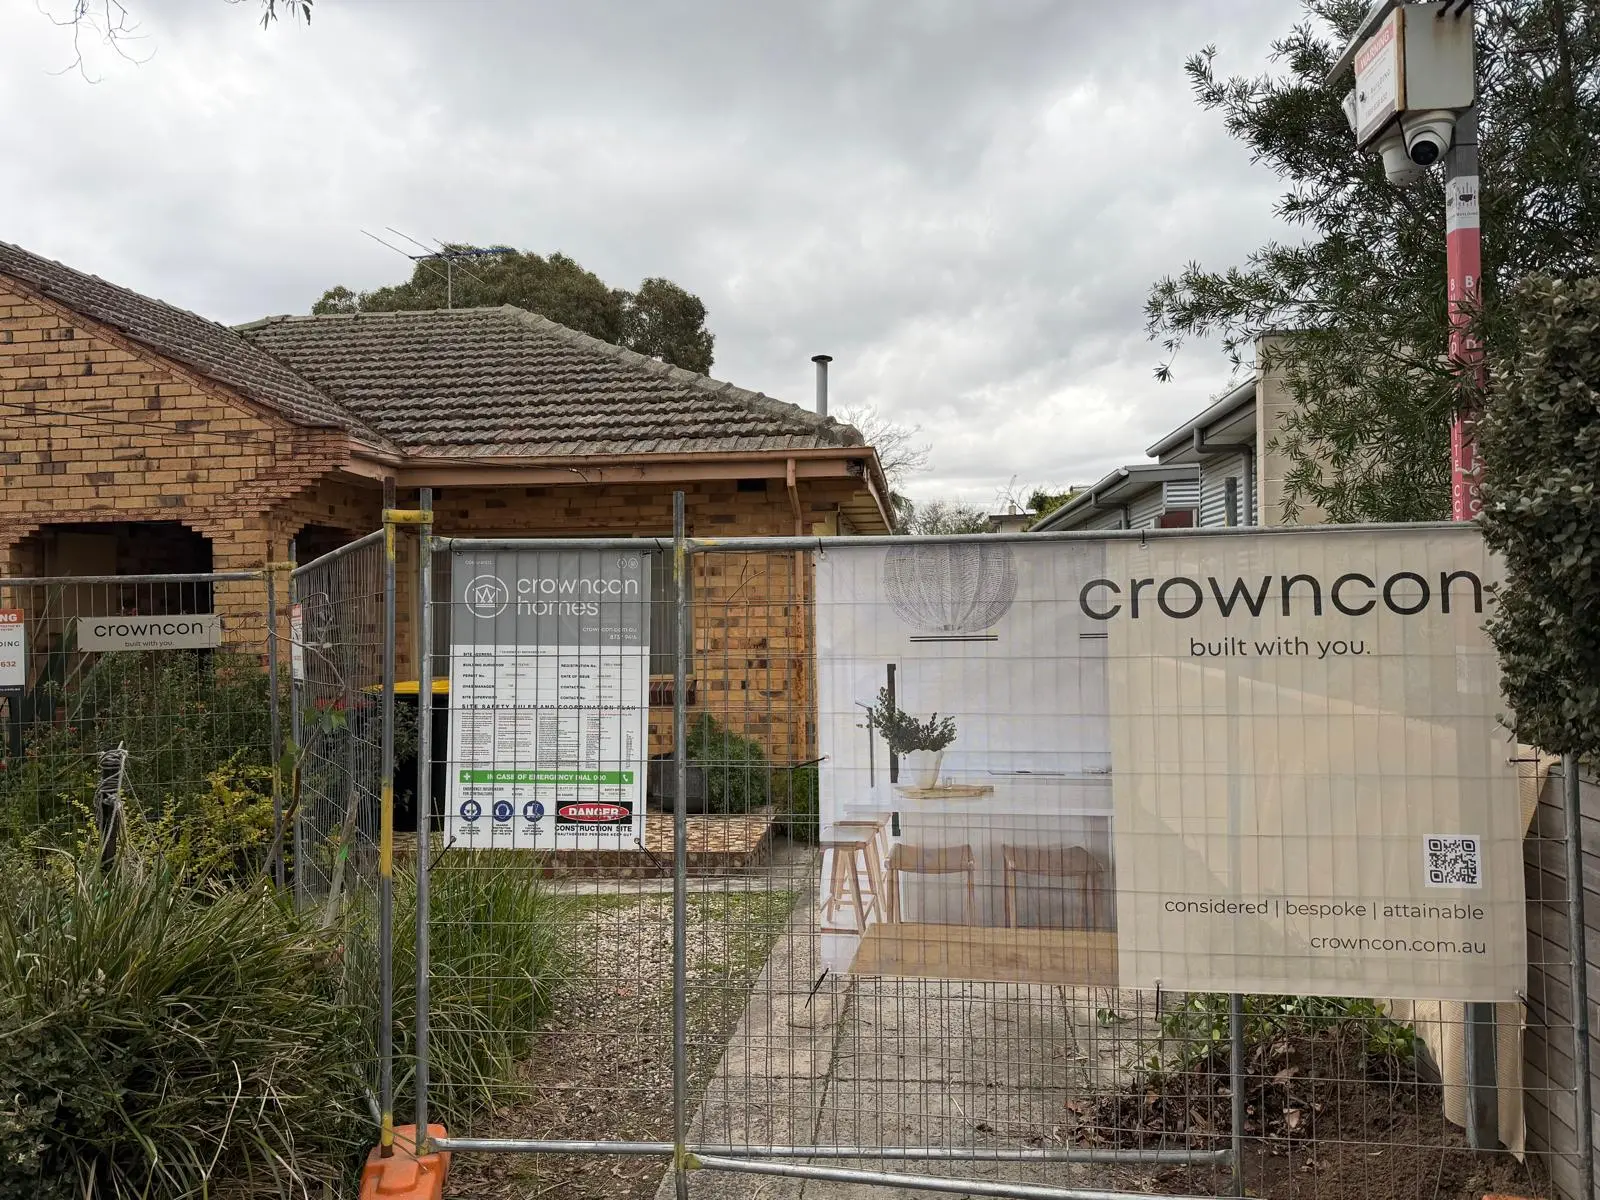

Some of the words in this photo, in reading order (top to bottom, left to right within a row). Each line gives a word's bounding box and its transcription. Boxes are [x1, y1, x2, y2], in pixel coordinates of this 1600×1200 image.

[1360, 30, 1390, 70] WARNING
[517, 577, 638, 595] crowncon
[1079, 570, 1483, 620] crowncon
[517, 596, 599, 617] homes
[94, 622, 203, 638] crowncon
[1190, 637, 1247, 656] built
[1254, 636, 1309, 656] with
[1316, 639, 1371, 660] you.
[568, 807, 619, 816] DANGER
[555, 824, 613, 832] CONSTRUCTION
[1164, 898, 1269, 915] considered
[1285, 901, 1367, 918] bespoke
[1383, 903, 1485, 921] attainable
[1310, 935, 1487, 954] crowncon.com.au
